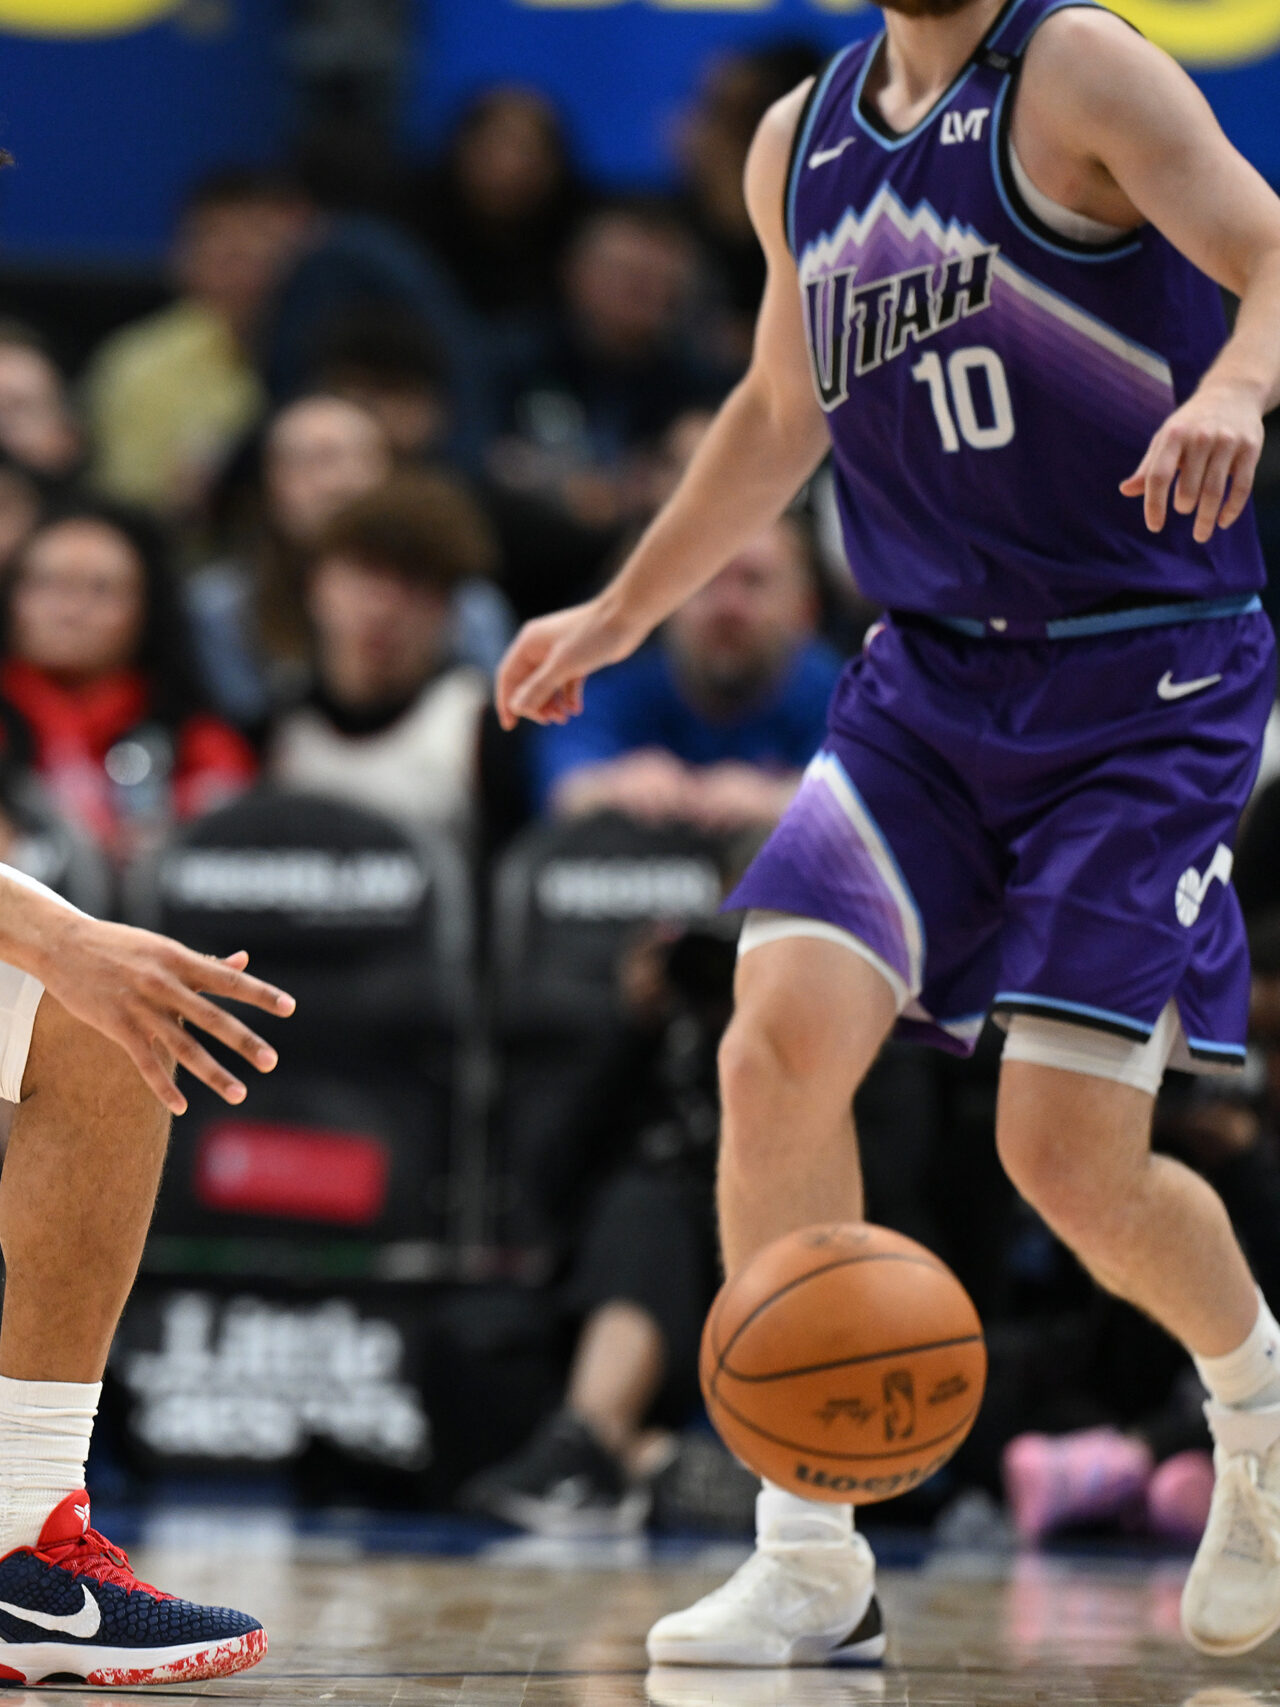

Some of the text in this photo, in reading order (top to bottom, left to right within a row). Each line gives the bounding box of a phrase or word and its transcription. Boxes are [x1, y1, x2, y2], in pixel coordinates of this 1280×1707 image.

[940, 107, 991, 145] LVT
[798, 244, 1000, 413] UTAH
[912, 345, 1015, 452] 10
